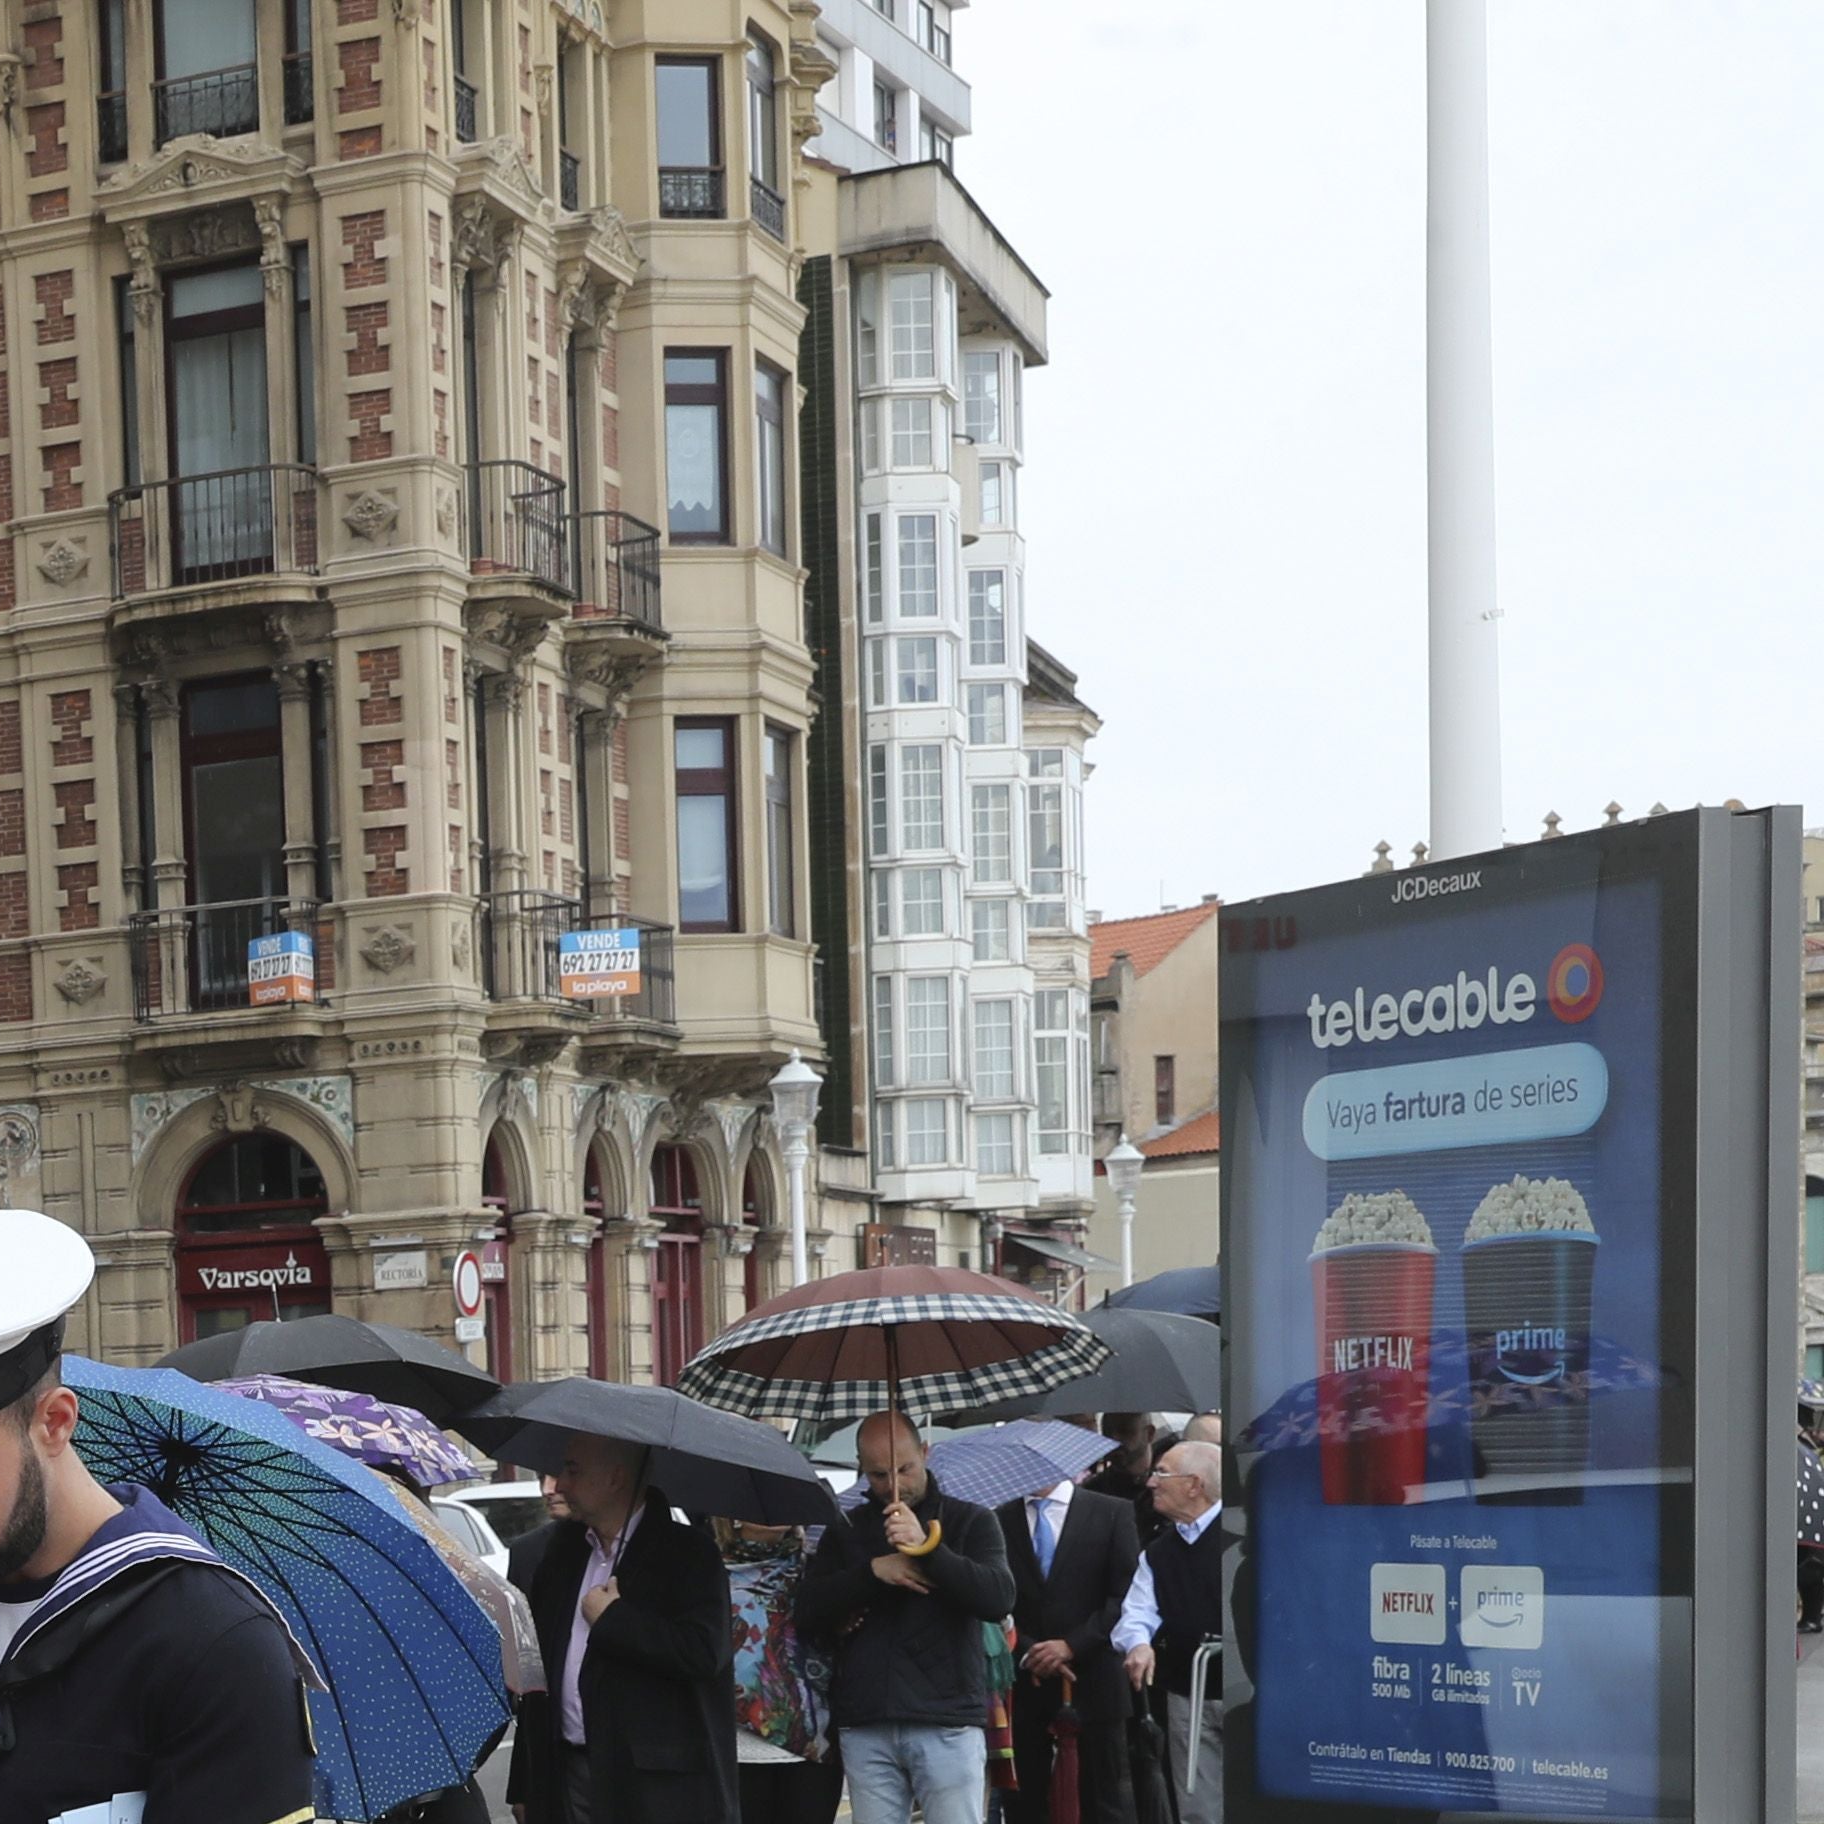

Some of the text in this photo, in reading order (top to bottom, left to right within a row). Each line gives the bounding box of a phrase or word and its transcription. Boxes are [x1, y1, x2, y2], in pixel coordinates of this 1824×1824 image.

[1391, 870, 1482, 903] JCDecaux
[577, 933, 621, 950] VENDE
[563, 951, 636, 974] 692 27 27 27
[1306, 965, 1537, 1049] telecable
[1326, 1073, 1579, 1135] Vaya fartura de series
[198, 1252, 312, 1290] Varsovia
[1334, 1336, 1414, 1373] NETFLIX
[1496, 1320, 1565, 1359] prime
[1382, 1591, 1435, 1616] NETFLIX
[1477, 1586, 1525, 1610] prime
[1372, 1655, 1411, 1680] fibra
[1431, 1662, 1491, 1688] 2 líneas
[1371, 1682, 1392, 1699] 500
[1512, 1681, 1542, 1707] TV
[1308, 1741, 1609, 1781] Contrátalo en Tiendas 900.825.700 telecable.es
